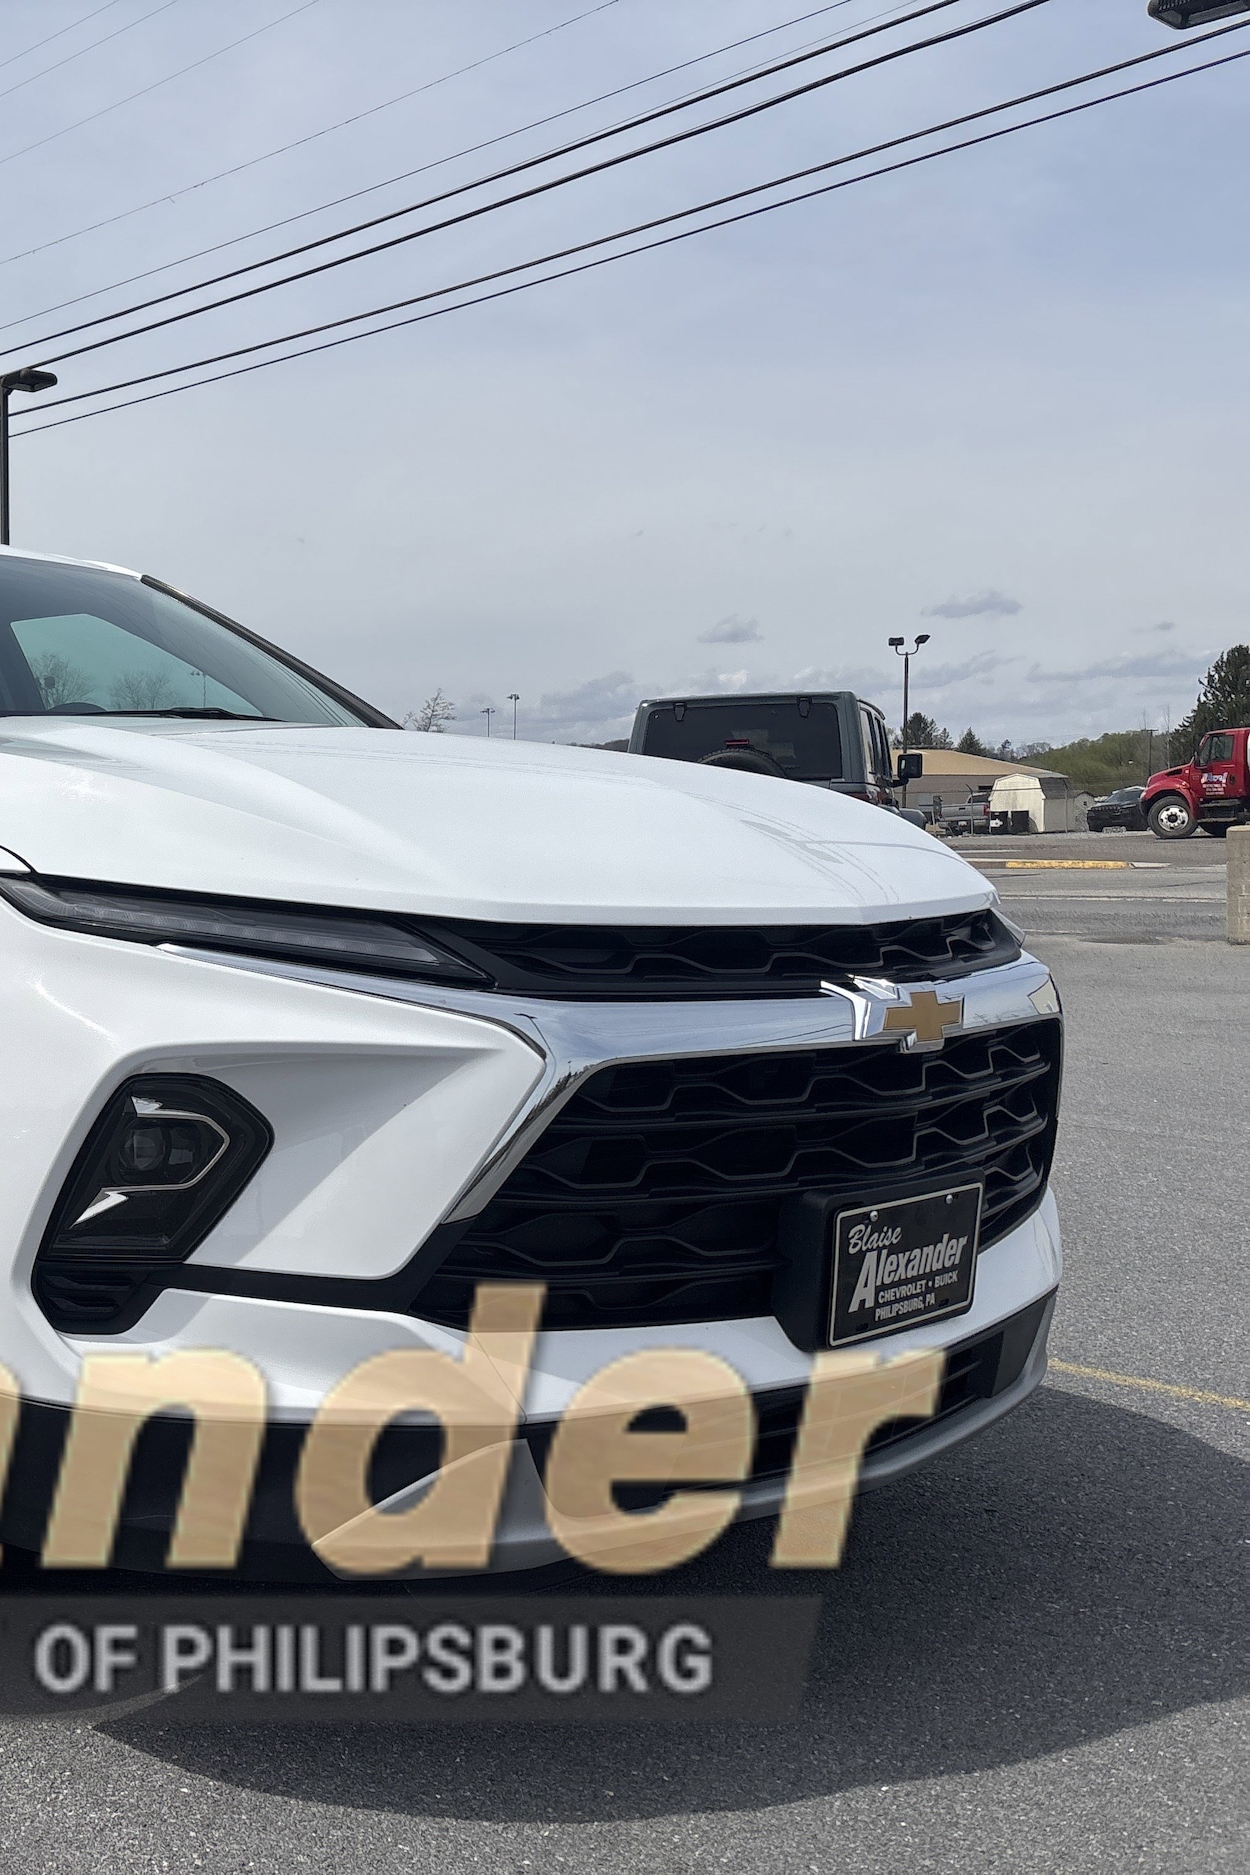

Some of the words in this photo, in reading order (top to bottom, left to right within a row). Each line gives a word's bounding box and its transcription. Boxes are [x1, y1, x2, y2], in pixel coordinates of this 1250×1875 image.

[848, 1223, 902, 1255] Blaise
[848, 1234, 968, 1313] Alexander
[878, 1279, 926, 1304] CHEVROLET
[934, 1270, 958, 1288] BUICK
[874, 1298, 925, 1321] PHILIPSBURG,
[925, 1292, 936, 1307] PA
